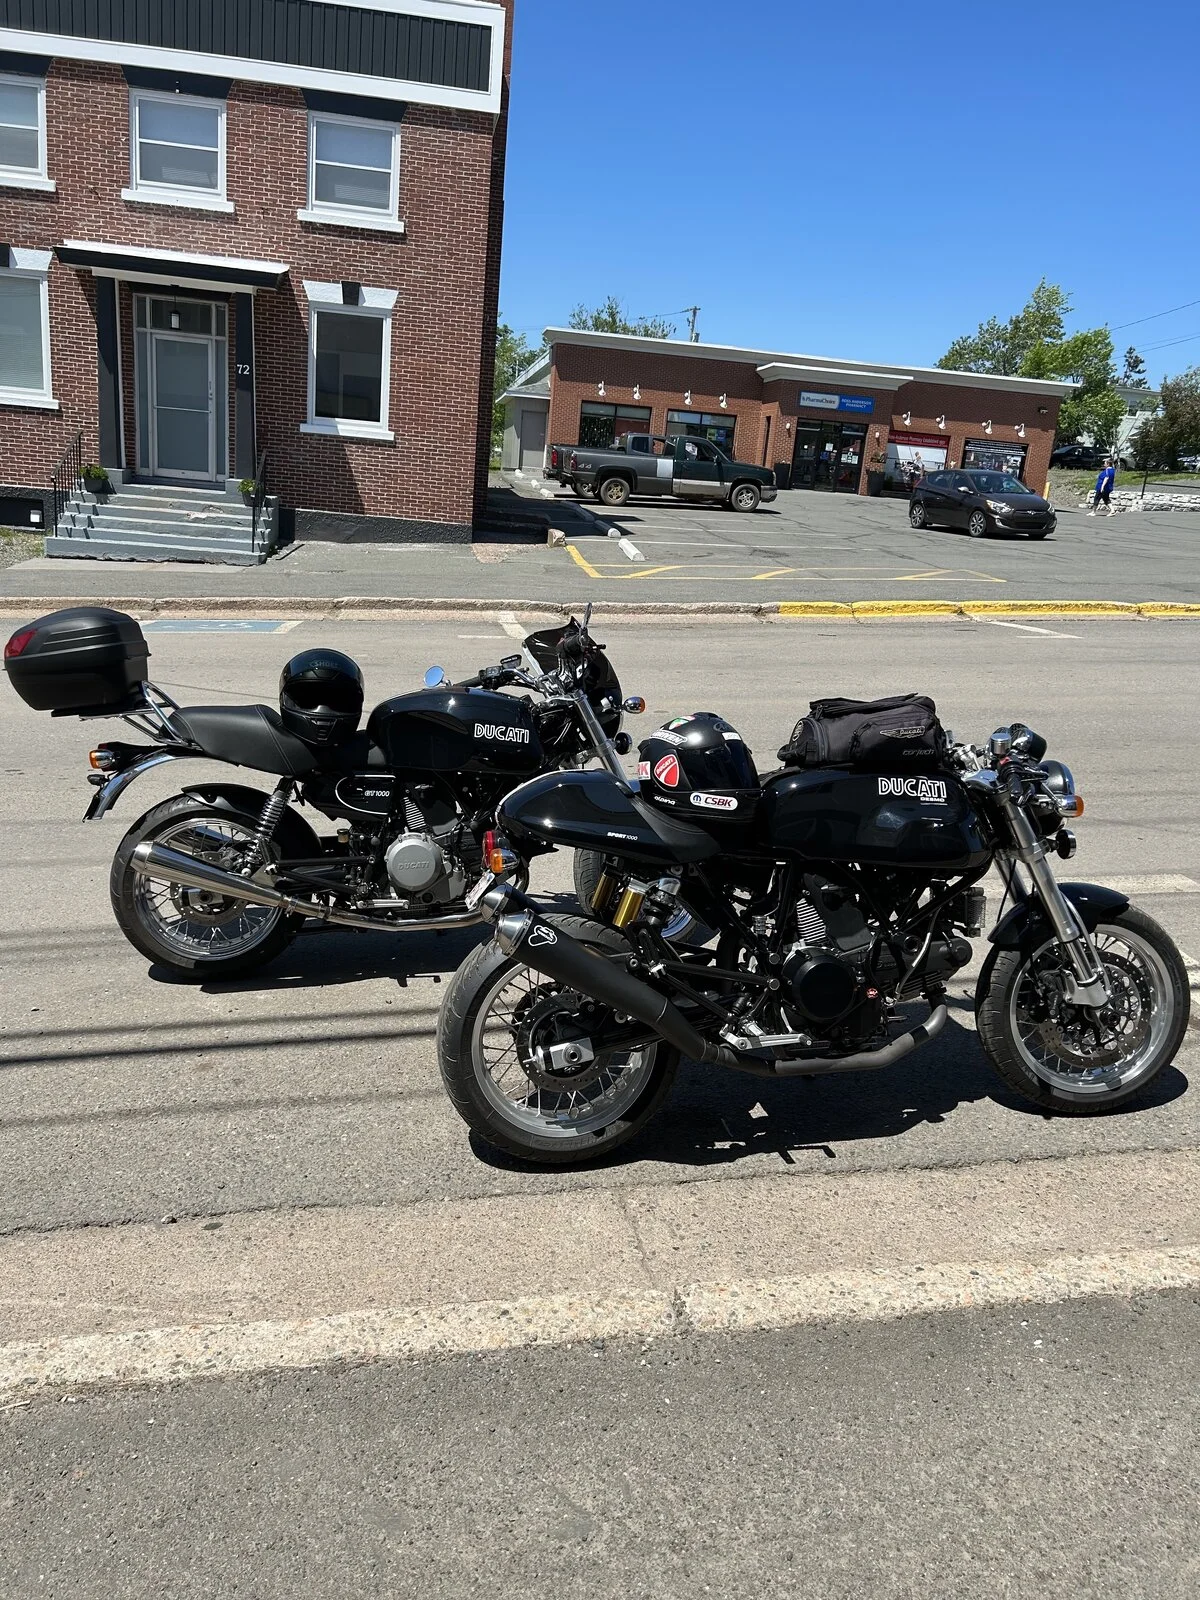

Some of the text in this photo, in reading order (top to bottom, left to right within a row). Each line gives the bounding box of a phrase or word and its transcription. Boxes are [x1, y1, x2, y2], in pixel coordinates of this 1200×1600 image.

[236, 364, 250, 375] 72
[474, 723, 530, 744] DUCATI
[656, 756, 674, 775] DUCATI
[878, 777, 947, 798] DUCATI
[704, 796, 733, 807] CSBK
[397, 861, 430, 871] DUCATI
